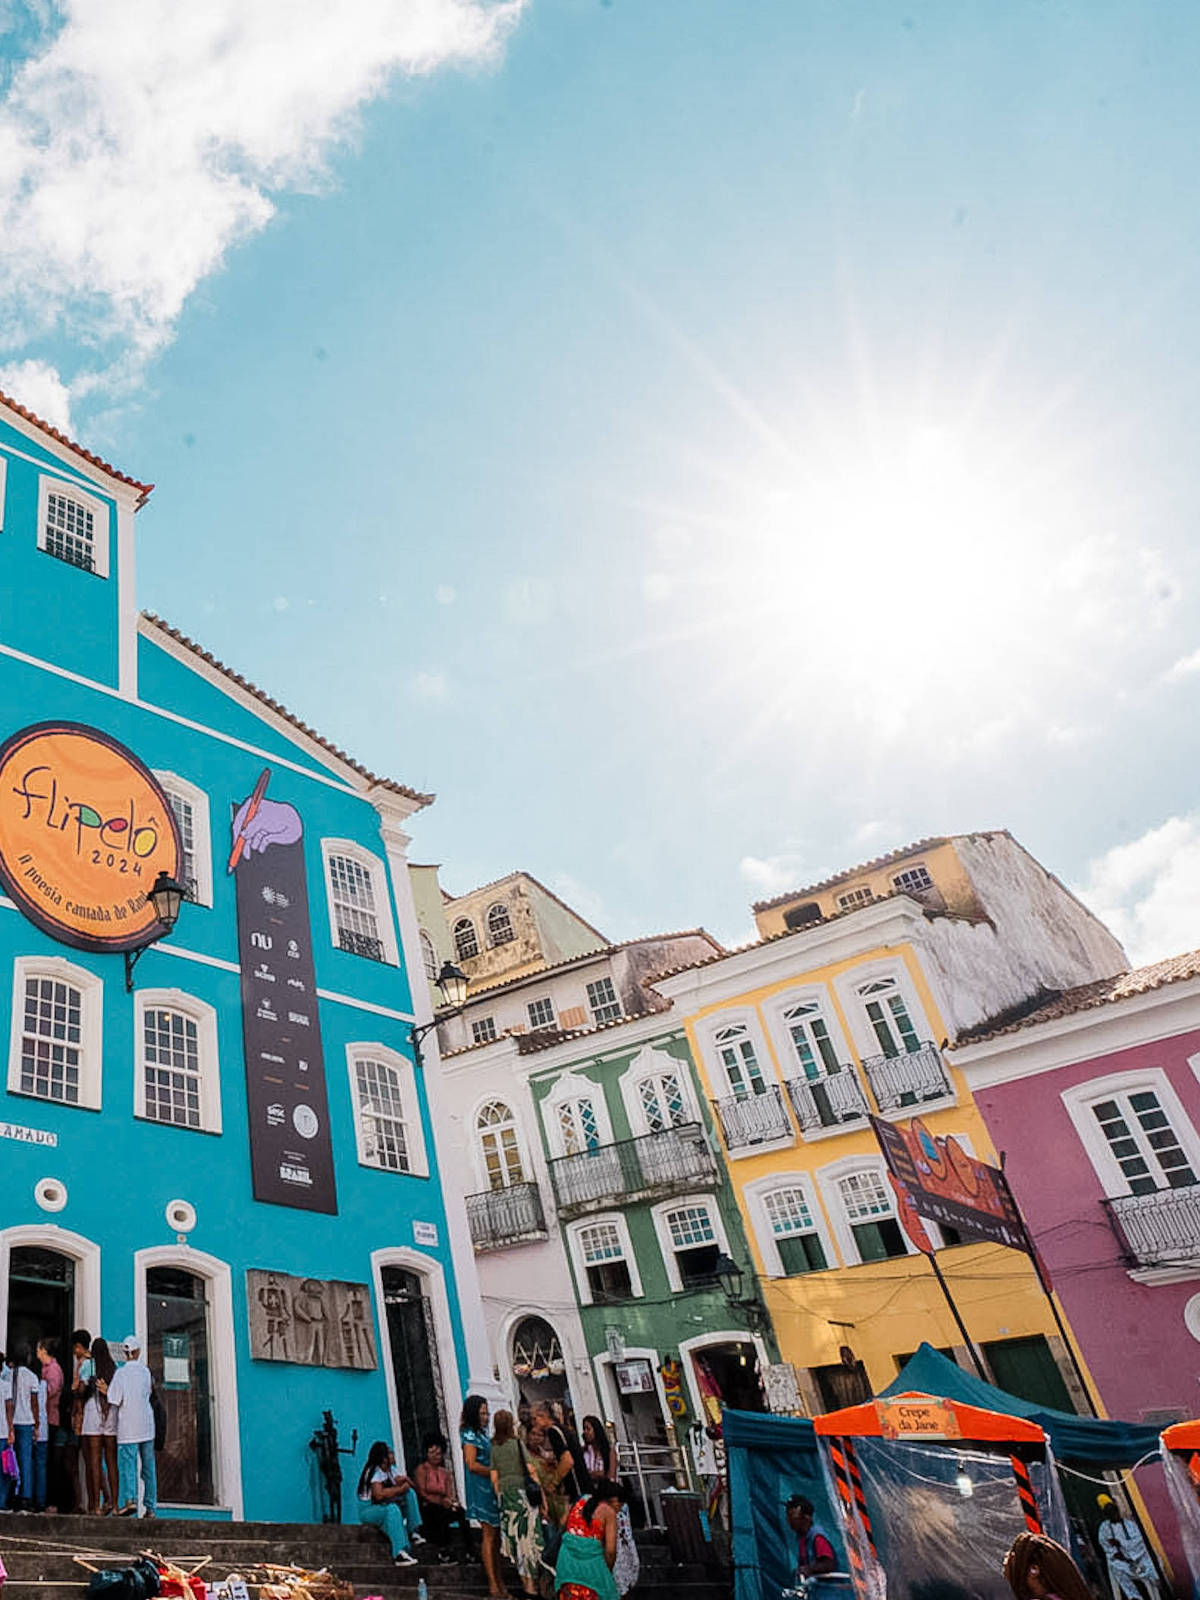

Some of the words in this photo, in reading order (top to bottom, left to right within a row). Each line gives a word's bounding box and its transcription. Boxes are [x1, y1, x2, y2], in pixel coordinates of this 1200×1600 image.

[91, 850, 143, 877] 2024
[24, 867, 63, 906] poesia
[65, 900, 112, 922] cantada
[113, 904, 128, 921] de
[3, 1124, 56, 1144] AMADO
